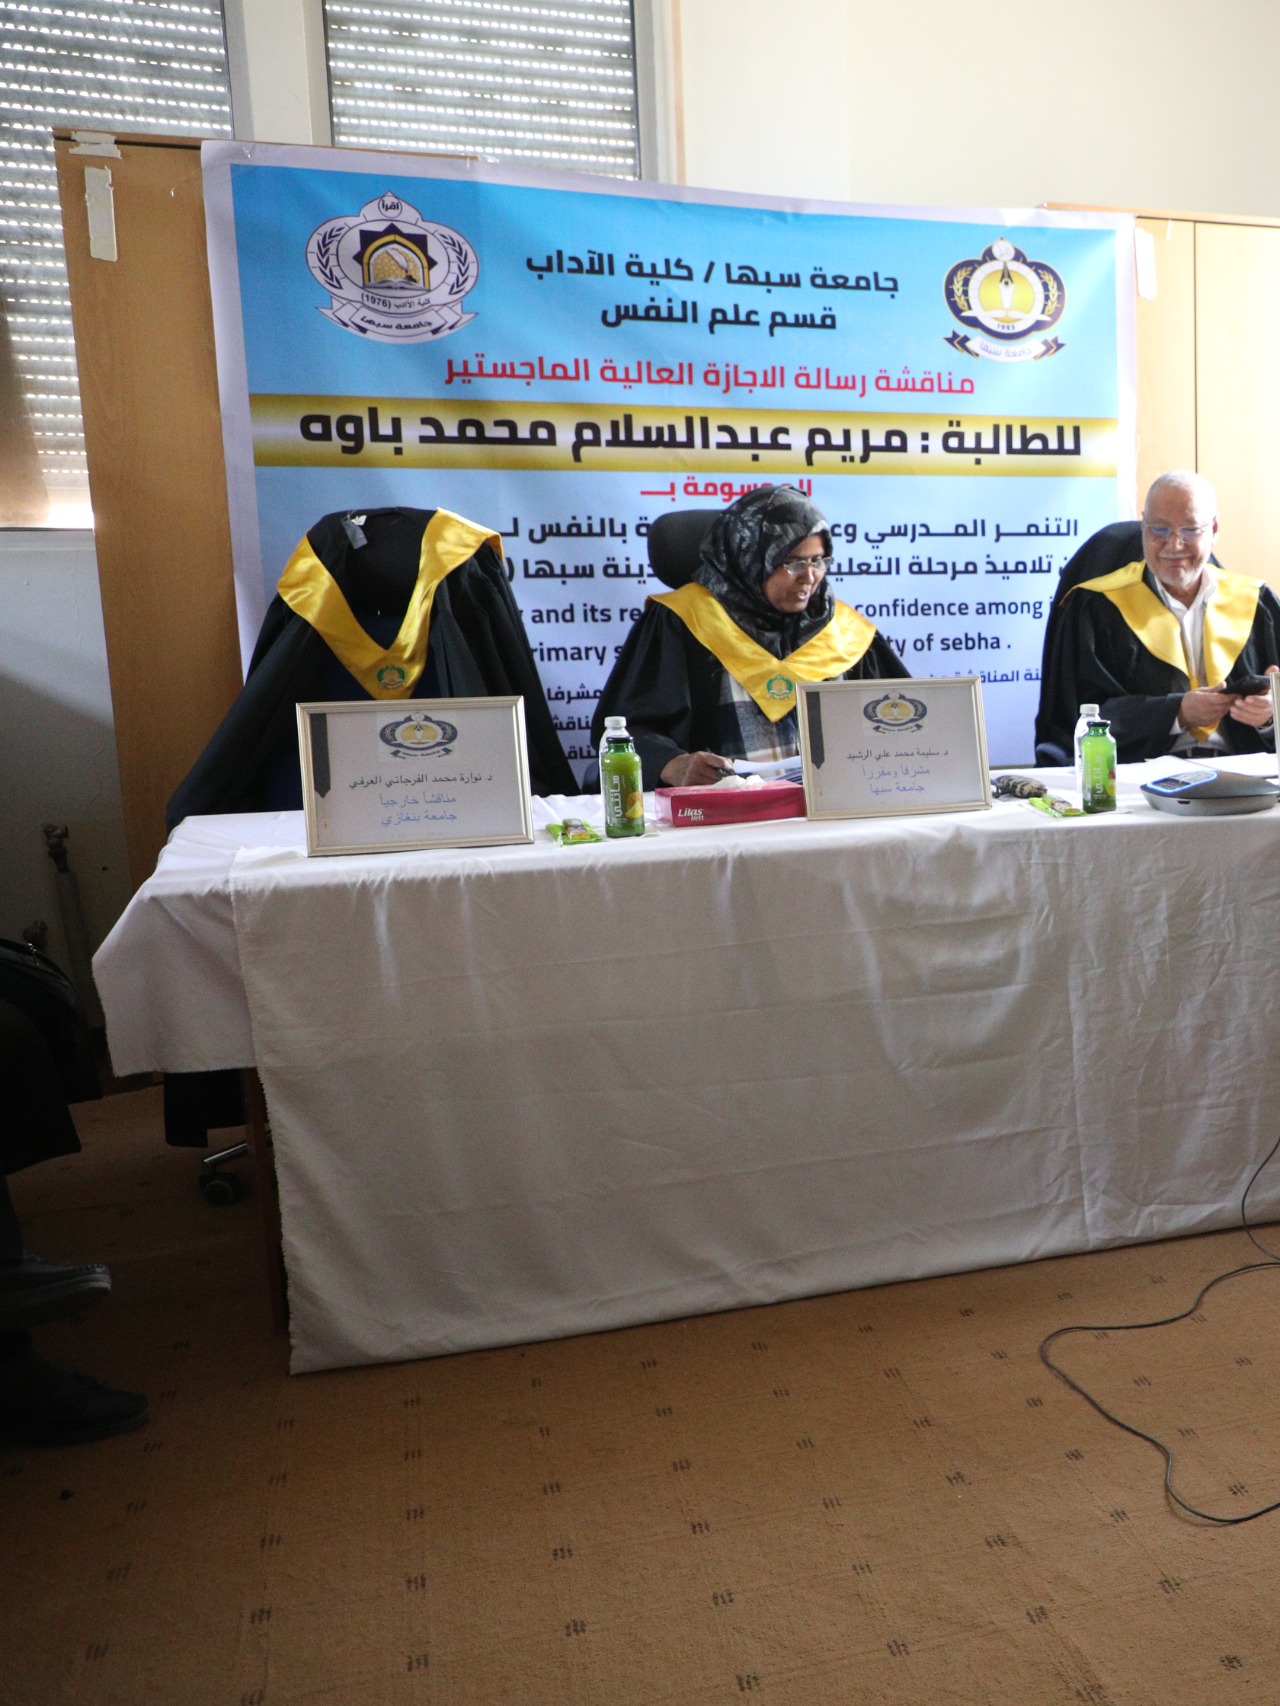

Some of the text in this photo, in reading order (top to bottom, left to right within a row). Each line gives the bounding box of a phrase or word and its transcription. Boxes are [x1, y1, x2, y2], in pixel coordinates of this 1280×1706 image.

[525, 249, 900, 299] جامعة سبها / كلية الآداب
[394, 320, 434, 331] جامعة
[600, 296, 837, 338] قسم علم النفس
[444, 352, 975, 398] مناقشة رسالة الاجازة العالية الماجستير
[299, 406, 1082, 467] للطالبة : مريم عبدالسلام محمد باوه
[683, 476, 811, 503] السومة
[527, 515, 628, 545] بالنفس
[522, 558, 595, 586] سبها
[825, 556, 901, 582] التعلي
[907, 555, 979, 581] مرحلة
[984, 554, 1053, 581] تلاميذ
[530, 603, 576, 625] and
[582, 603, 613, 624] its
[975, 600, 1044, 620] among
[913, 632, 935, 653] of
[940, 631, 1001, 652] sebha
[874, 748, 891, 762] علي
[431, 775, 458, 783] محمد
[869, 780, 926, 797] جامعة سبها
[380, 810, 458, 828] جامعة بنغازي
[677, 807, 704, 817] Lilas
